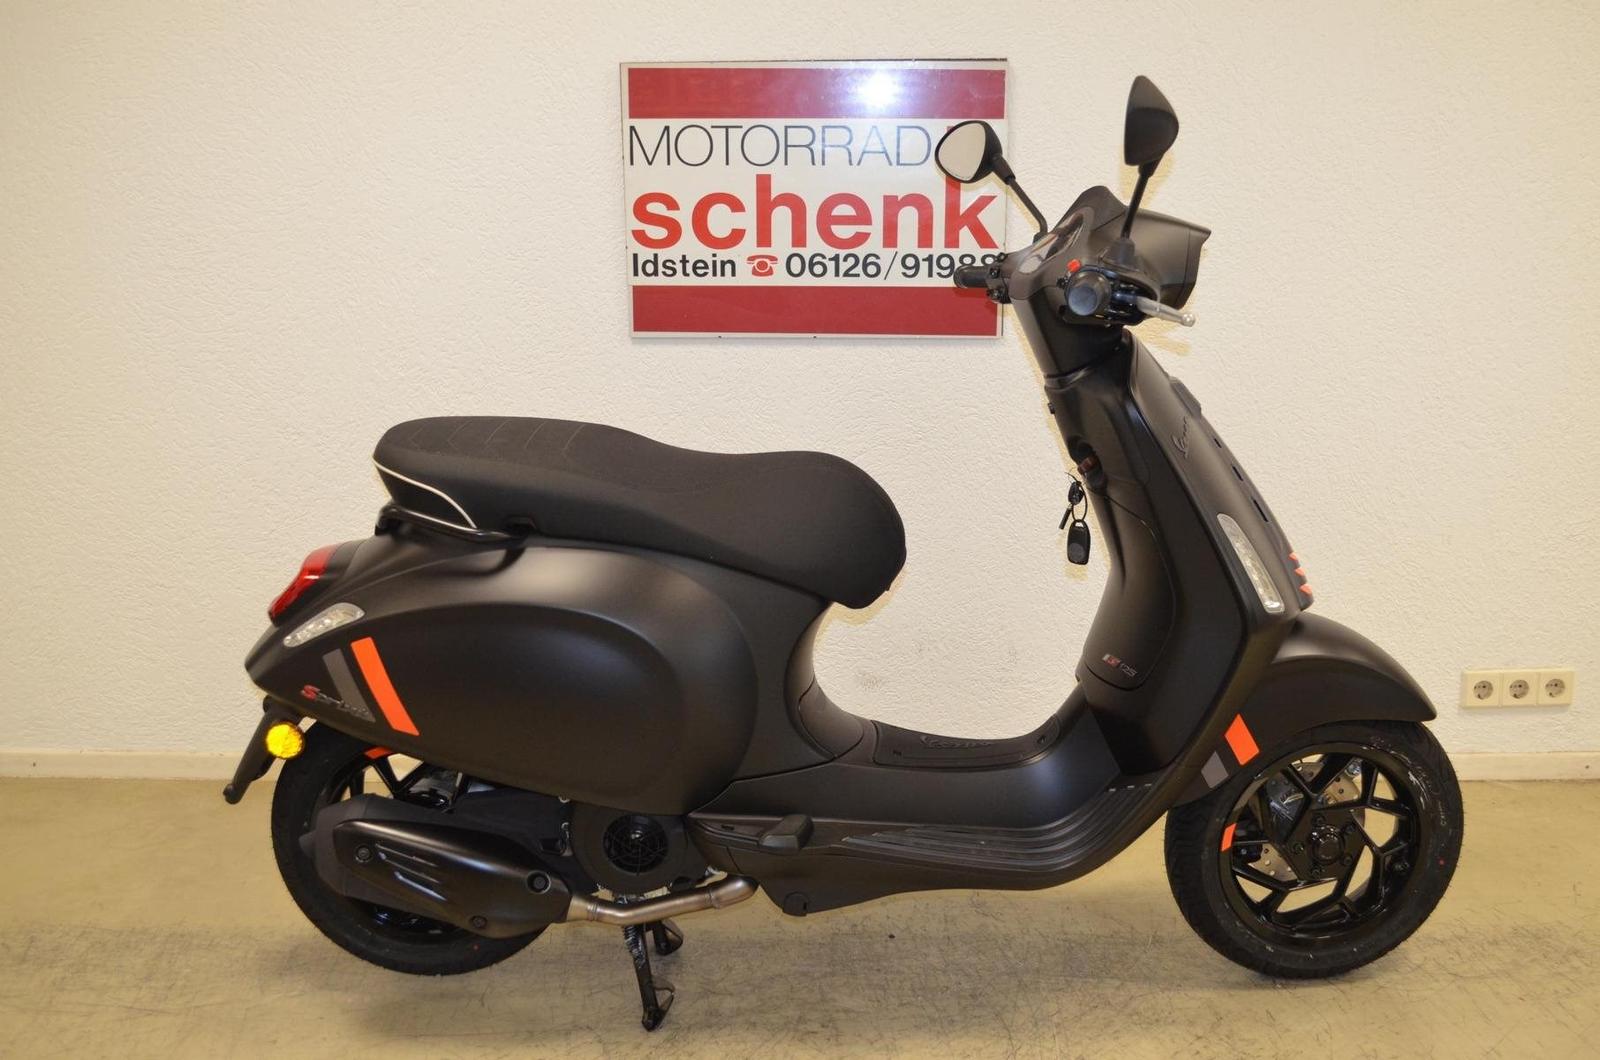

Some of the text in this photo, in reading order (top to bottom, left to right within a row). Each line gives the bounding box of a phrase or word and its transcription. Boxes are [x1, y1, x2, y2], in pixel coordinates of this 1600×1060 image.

[629, 124, 932, 167] MOTORRAD
[631, 173, 999, 250] schenk
[632, 252, 737, 278] Idstein
